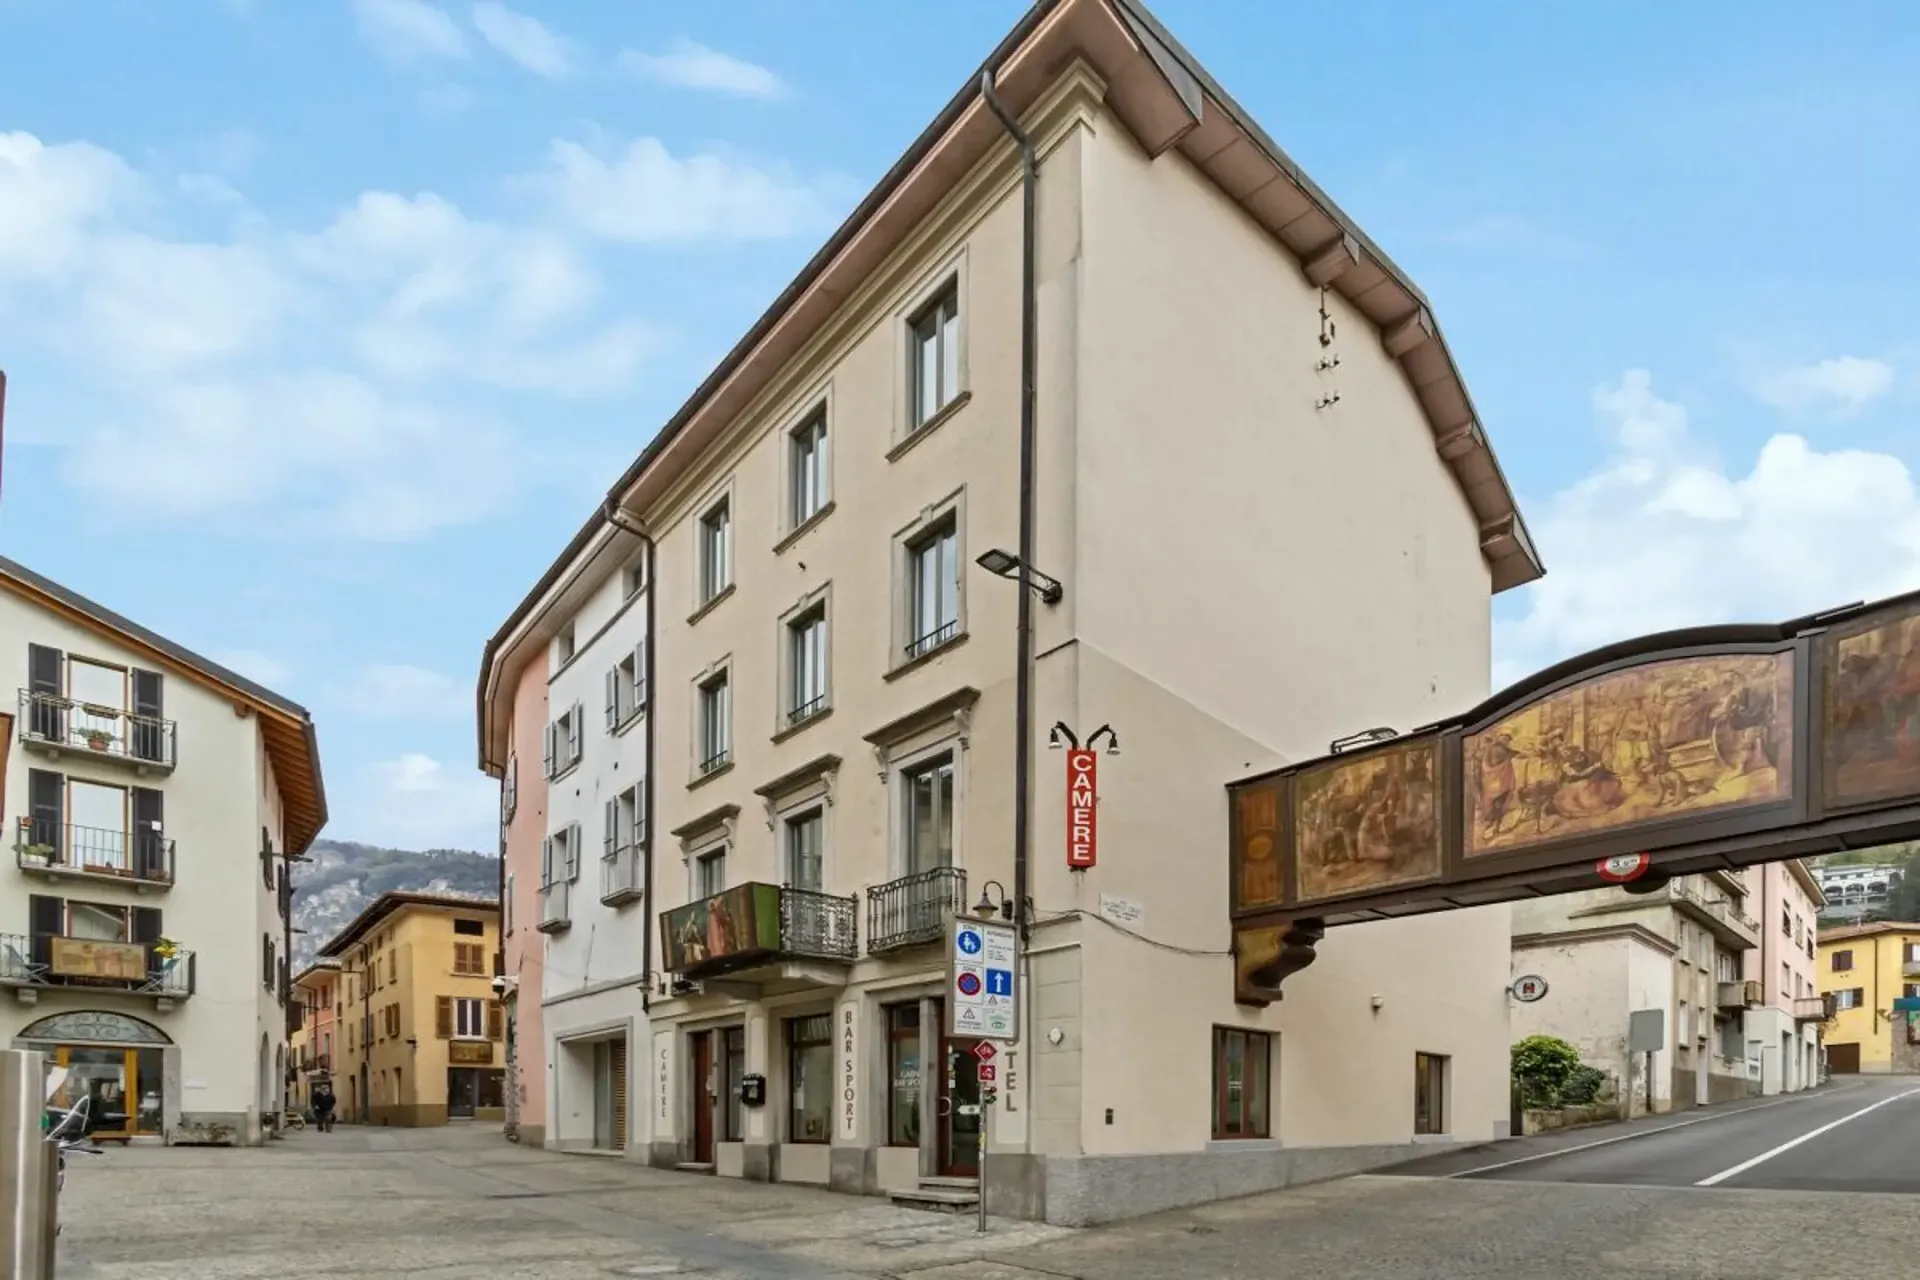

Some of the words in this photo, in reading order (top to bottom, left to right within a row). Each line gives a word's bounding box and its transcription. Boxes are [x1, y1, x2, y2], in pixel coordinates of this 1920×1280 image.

[1072, 754, 1093, 860] CAMERE
[845, 1011, 853, 1053] BAR
[844, 1060, 855, 1130] SPORT
[1003, 1040, 1018, 1112] TEL
